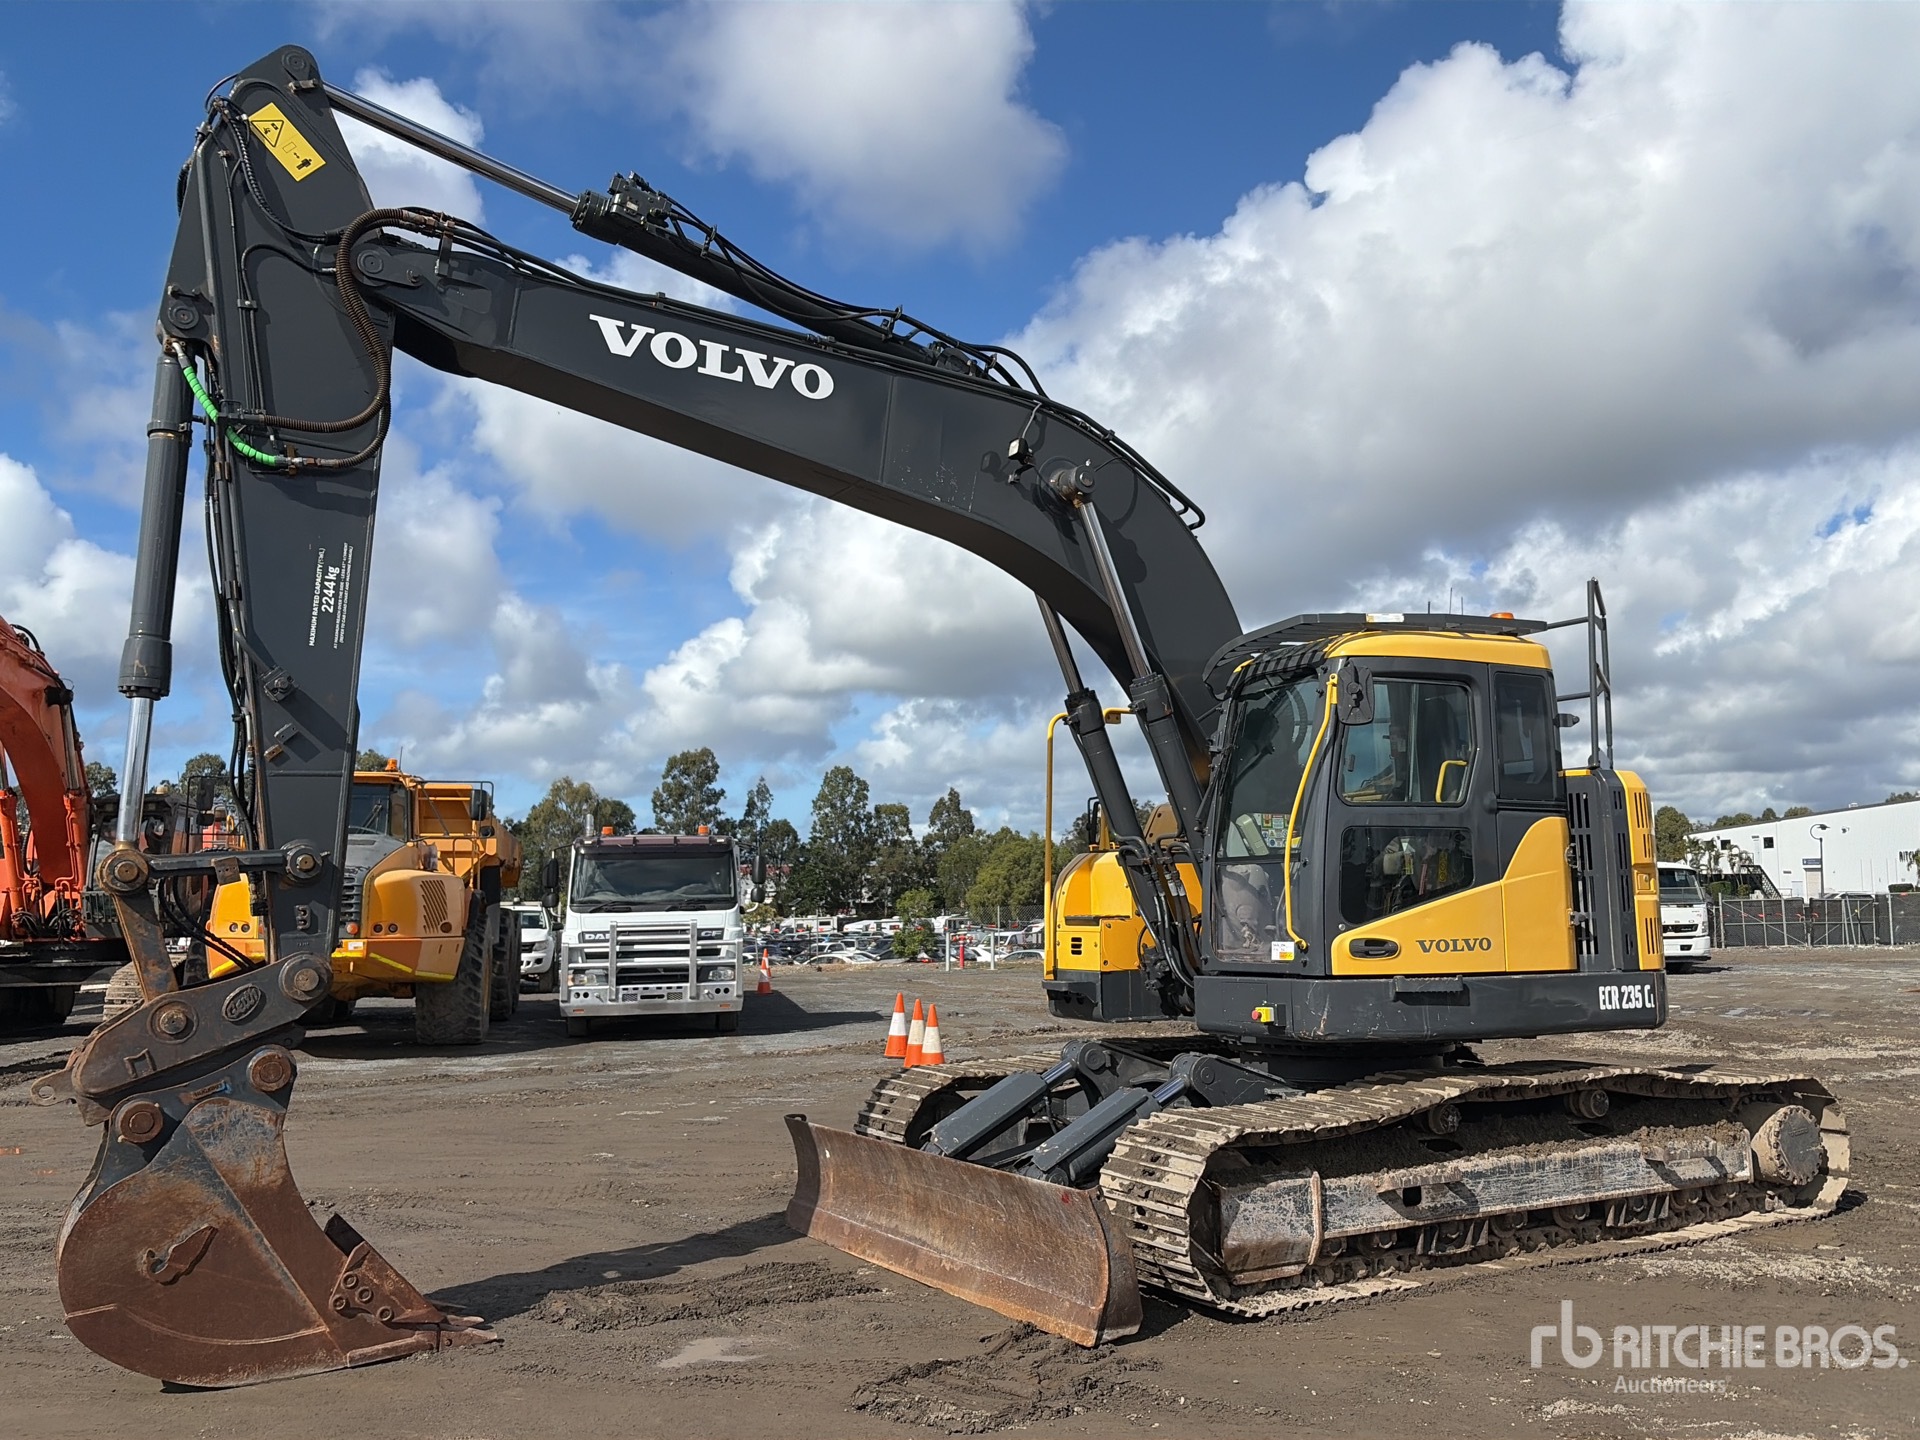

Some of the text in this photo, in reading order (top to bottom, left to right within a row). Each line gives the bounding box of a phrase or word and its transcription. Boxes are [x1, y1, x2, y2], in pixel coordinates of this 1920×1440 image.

[589, 314, 834, 400] VOLVO
[309, 616, 317, 646] MAXIMUM
[314, 564, 323, 594] CAPACITY
[321, 566, 340, 613] 2244 kg
[1416, 937, 1492, 953] VOLVO
[1599, 986, 1620, 1010] ECR
[1621, 985, 1642, 1009] 235
